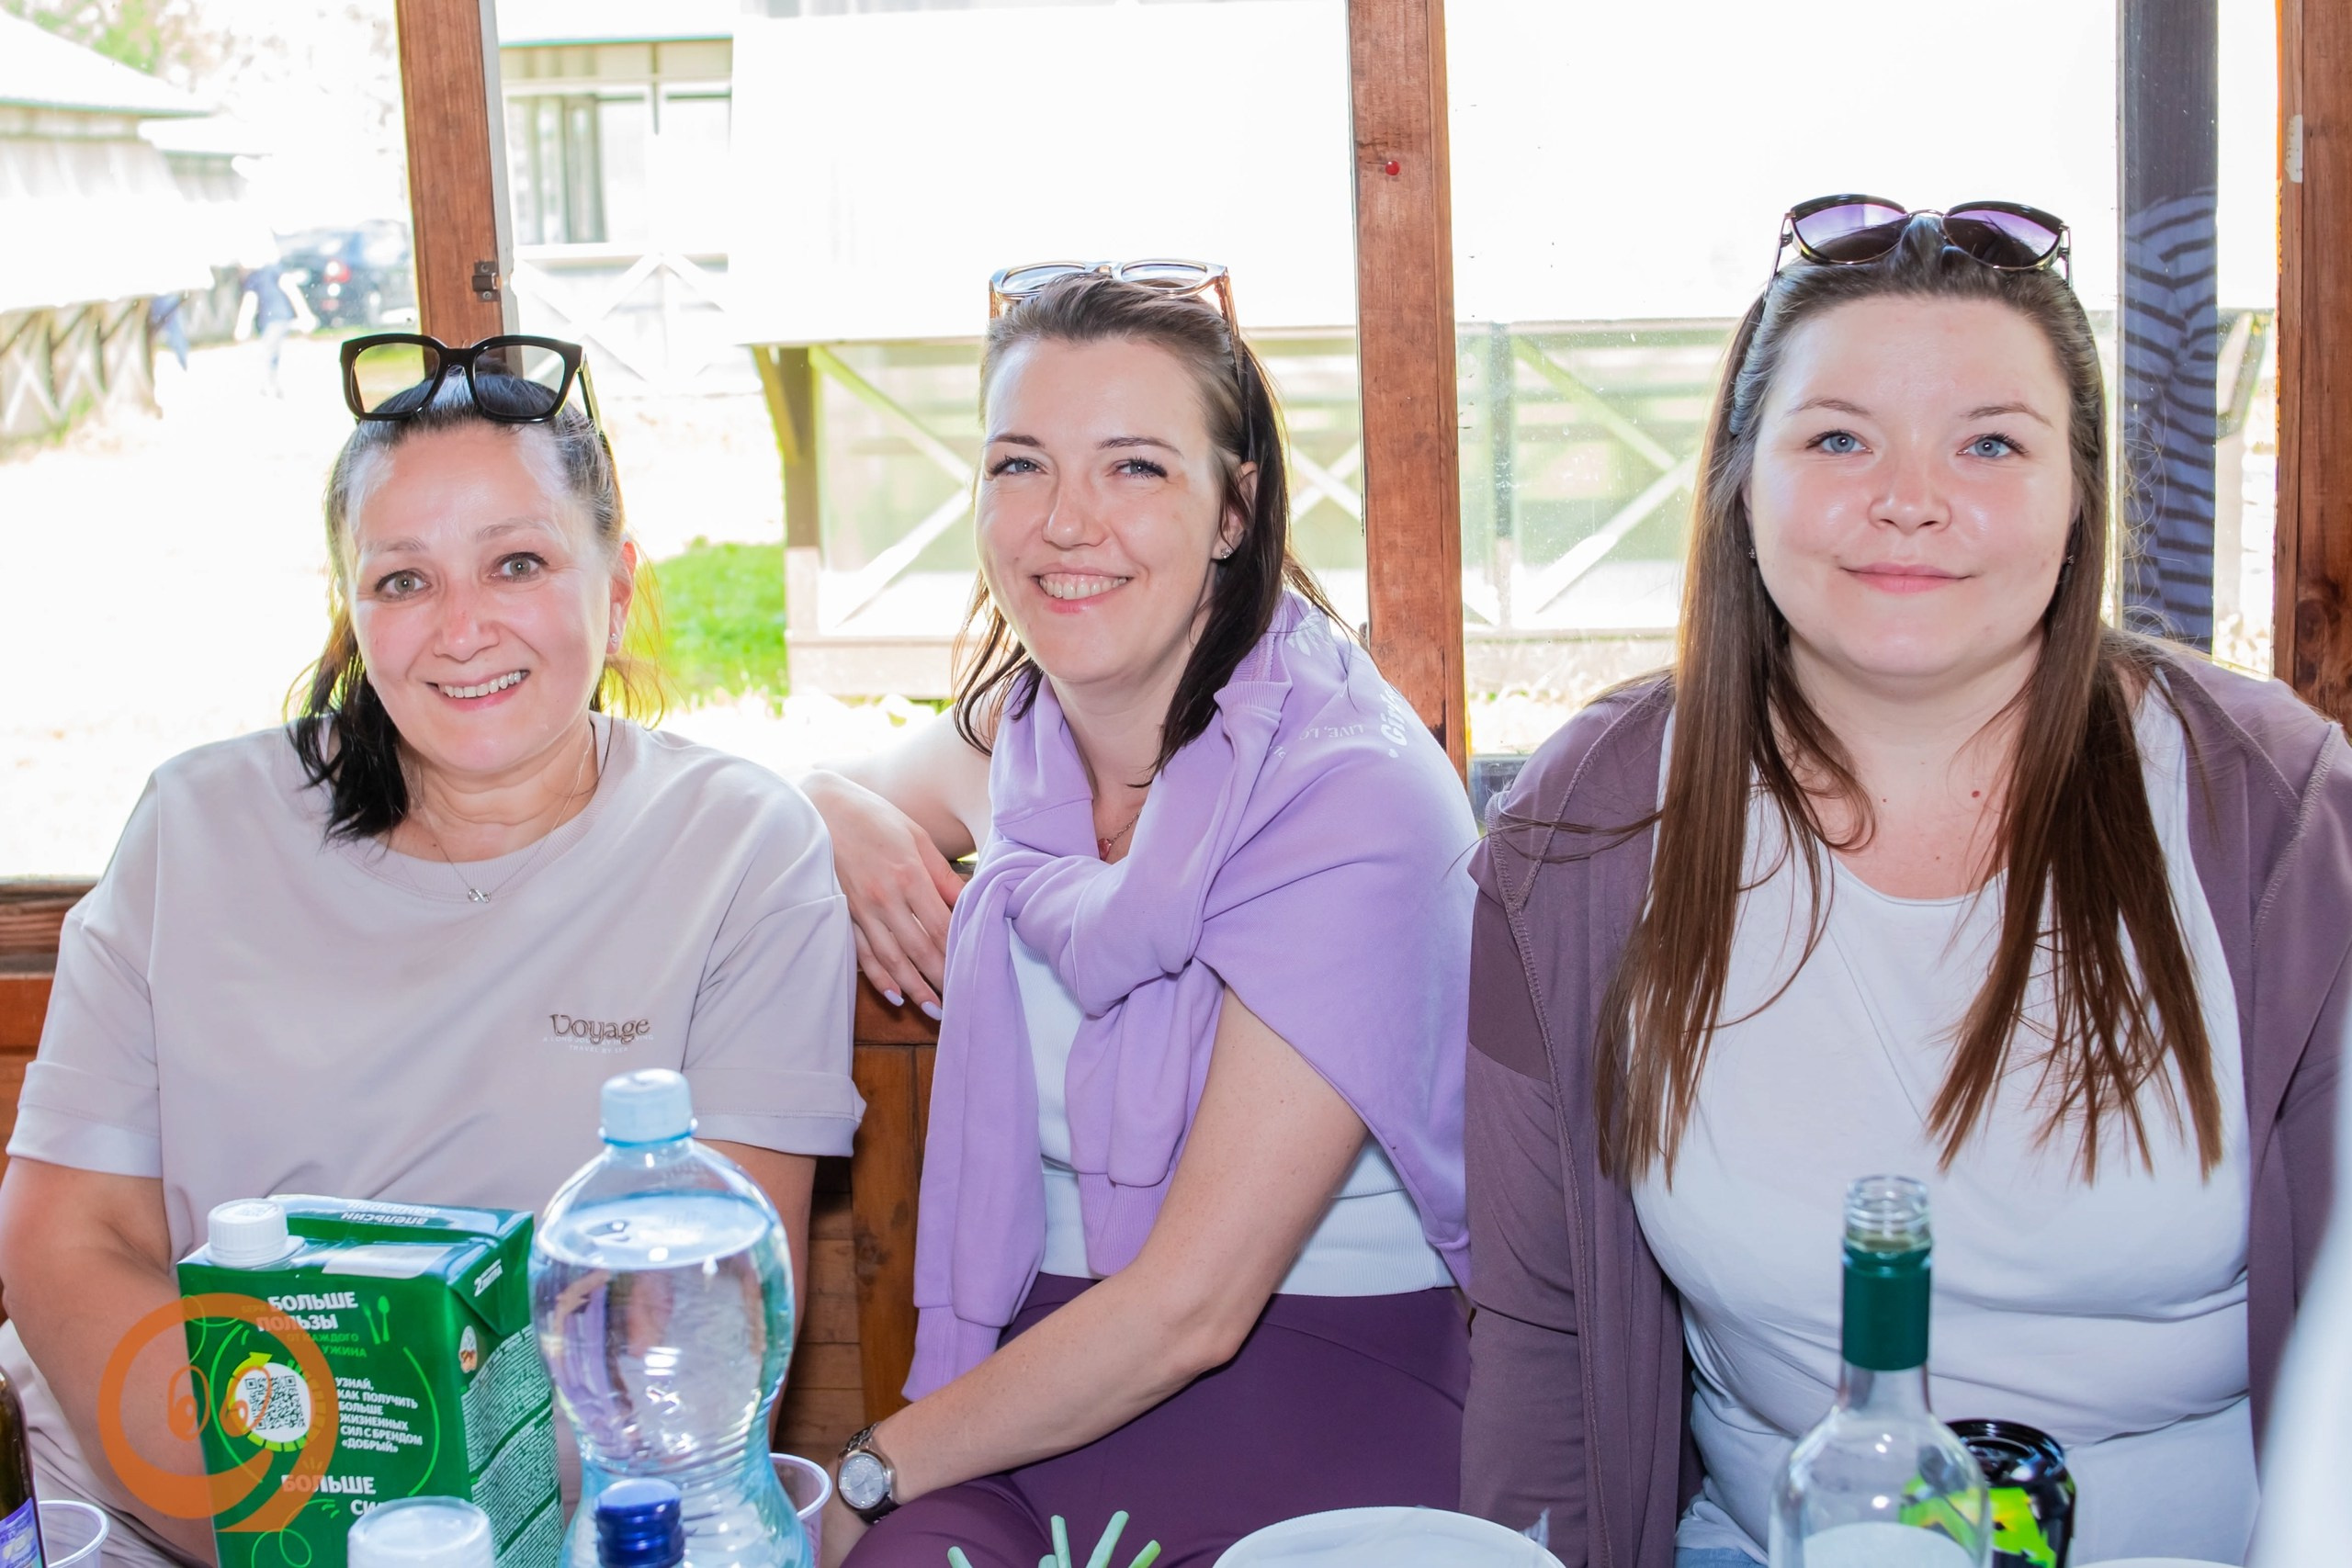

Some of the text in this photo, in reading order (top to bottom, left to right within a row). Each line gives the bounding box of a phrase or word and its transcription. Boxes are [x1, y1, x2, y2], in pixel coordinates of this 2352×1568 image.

[1324, 724, 1364, 738] LIVE,
[549, 1014, 650, 1044] Voyage
[569, 1044, 599, 1053] TRAVEL
[341, 1212, 429, 1225] апельсин
[267, 1292, 358, 1311] БОЛЬШЕ
[256, 1314, 338, 1331] ПОЛЬЗЫ
[322, 1345, 367, 1358] УЖИНА
[334, 1376, 374, 1391] УЗНАЙ,
[337, 1389, 418, 1409] КАК ПОЛУЧИТЬ
[338, 1402, 384, 1416] БОЛЬШЕ
[339, 1414, 409, 1431] ЖИЗНЕННЫХ
[340, 1426, 423, 1446] СИЛ С БРЕНДОМ
[342, 1438, 399, 1453] «ДОБРЫЙ»
[281, 1474, 377, 1495] БОЛЬШЕ
